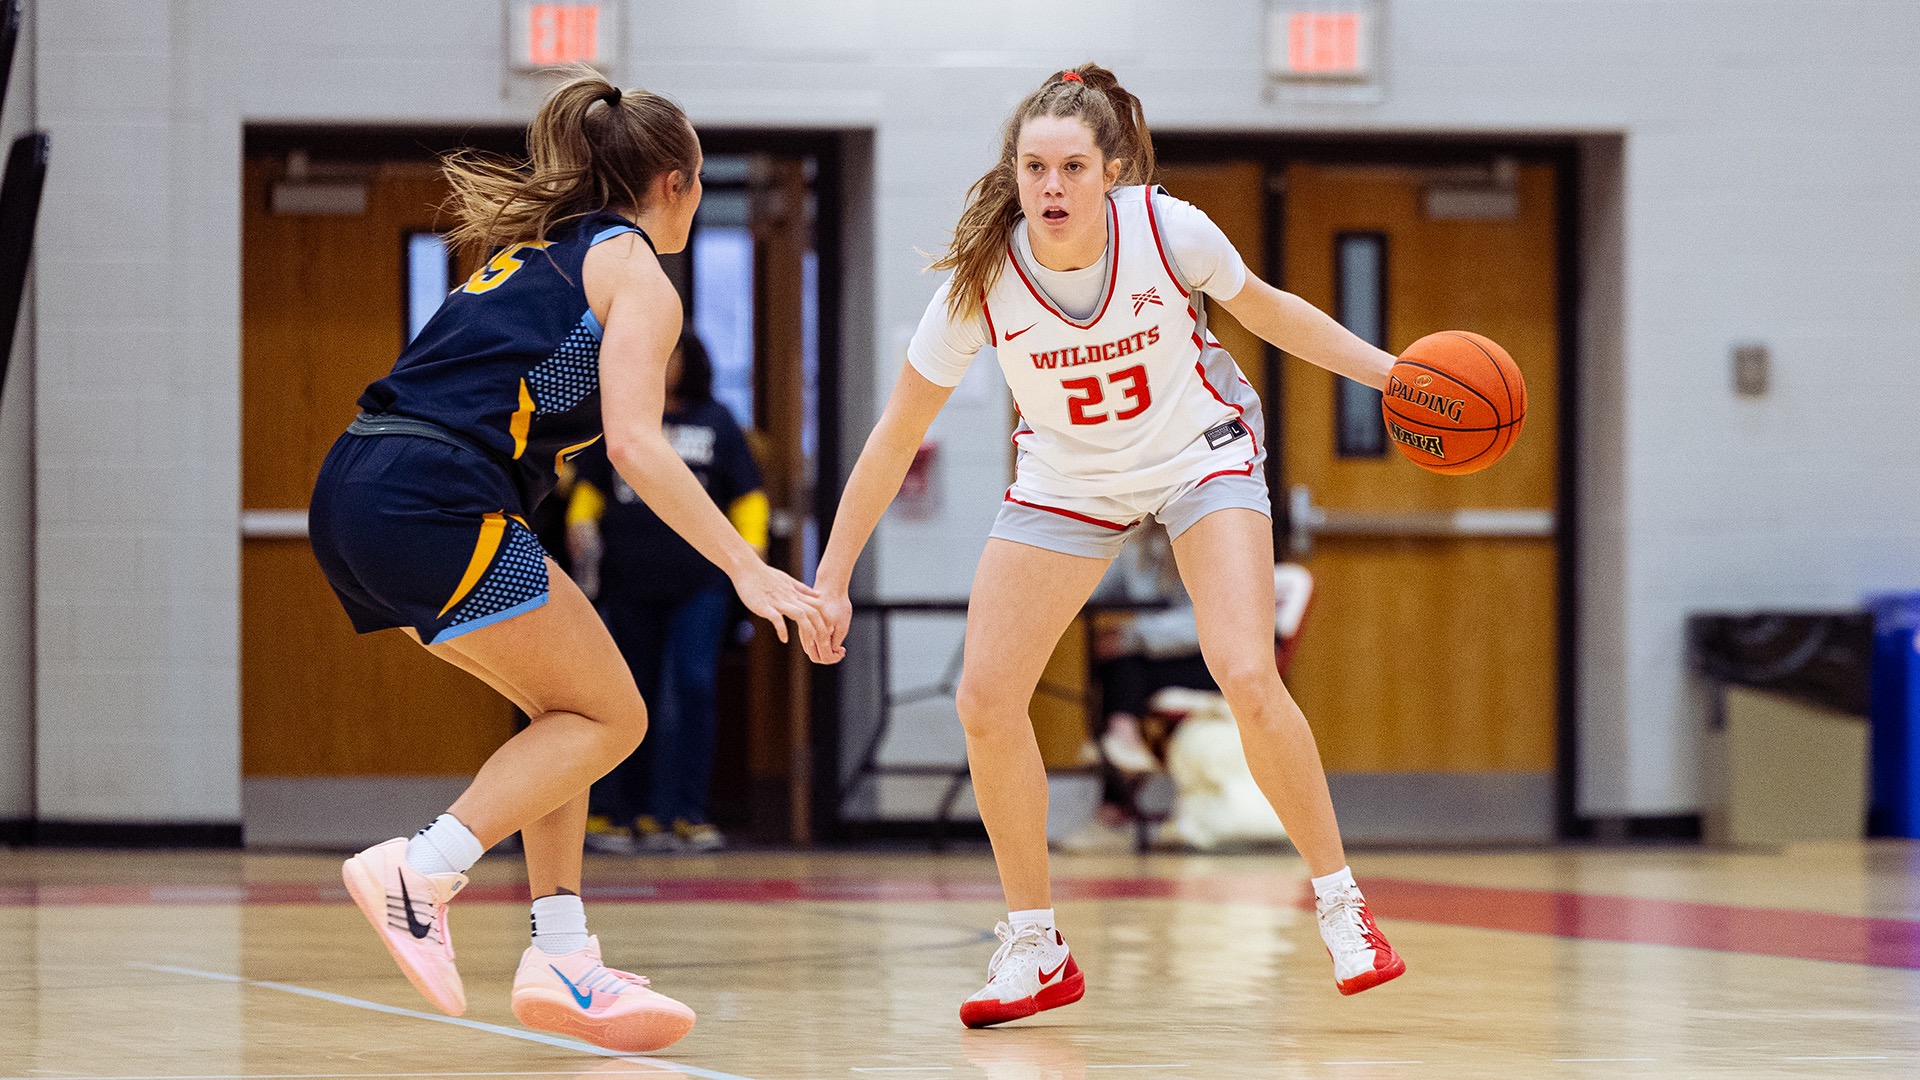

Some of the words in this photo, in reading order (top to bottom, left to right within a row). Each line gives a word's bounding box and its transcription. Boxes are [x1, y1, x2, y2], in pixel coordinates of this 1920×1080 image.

[1029, 325, 1160, 370] WILDCATS
[1060, 363, 1153, 426] 23
[1386, 375, 1465, 424] SPALDING
[1389, 419, 1445, 459] NAIA
